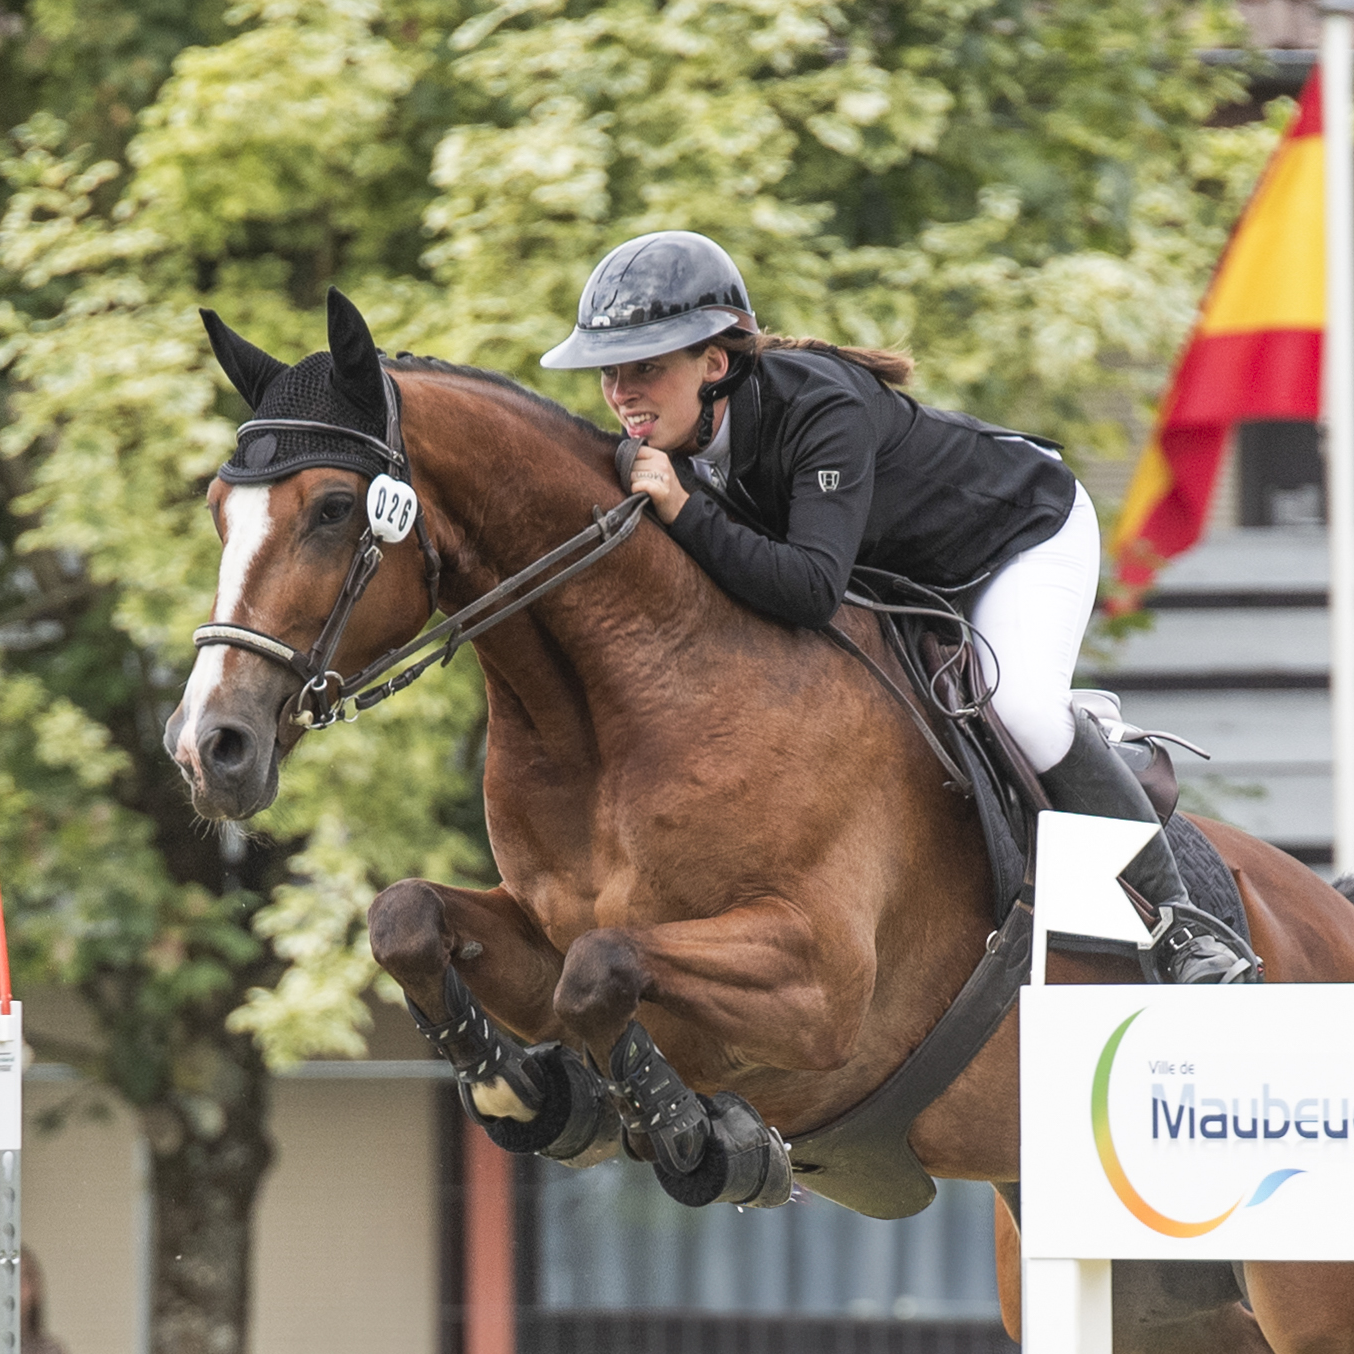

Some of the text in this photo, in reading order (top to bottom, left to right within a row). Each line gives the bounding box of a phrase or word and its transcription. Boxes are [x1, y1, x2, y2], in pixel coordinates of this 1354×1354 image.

[375, 486, 412, 532] 026
[1148, 1061, 1195, 1075] Ville de
